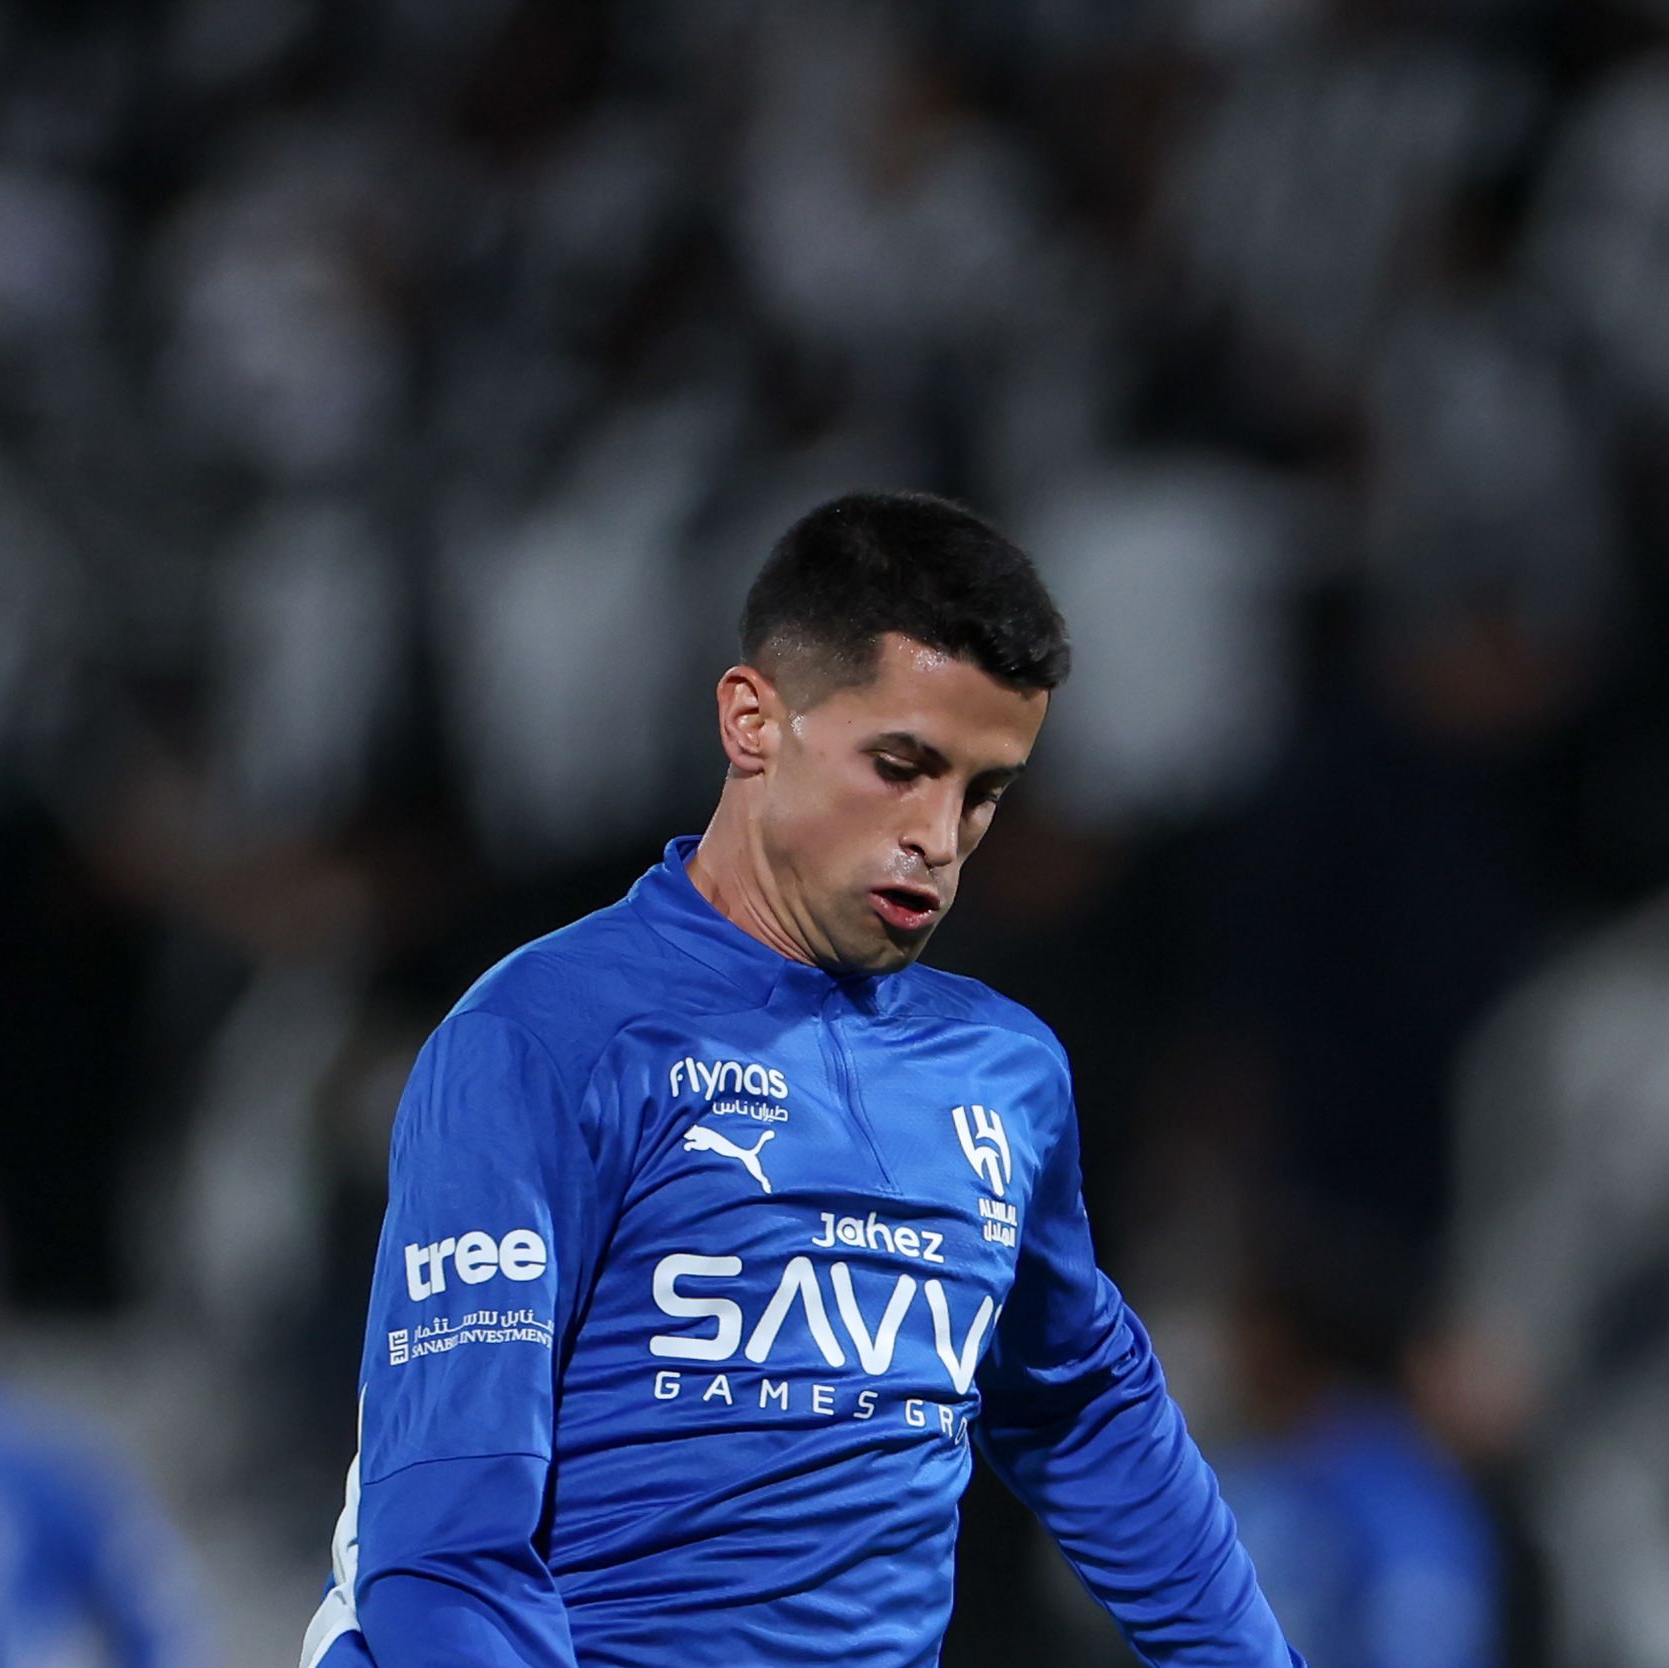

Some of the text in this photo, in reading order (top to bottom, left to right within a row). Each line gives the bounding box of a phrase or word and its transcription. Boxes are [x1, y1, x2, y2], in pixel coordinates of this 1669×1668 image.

[670, 1056, 789, 1101] flynas
[712, 1099, 789, 1124] طيران ناس
[404, 1228, 547, 1303] tree
[649, 1253, 1003, 1395] SAVV
[652, 1370, 879, 1420] GAMES
